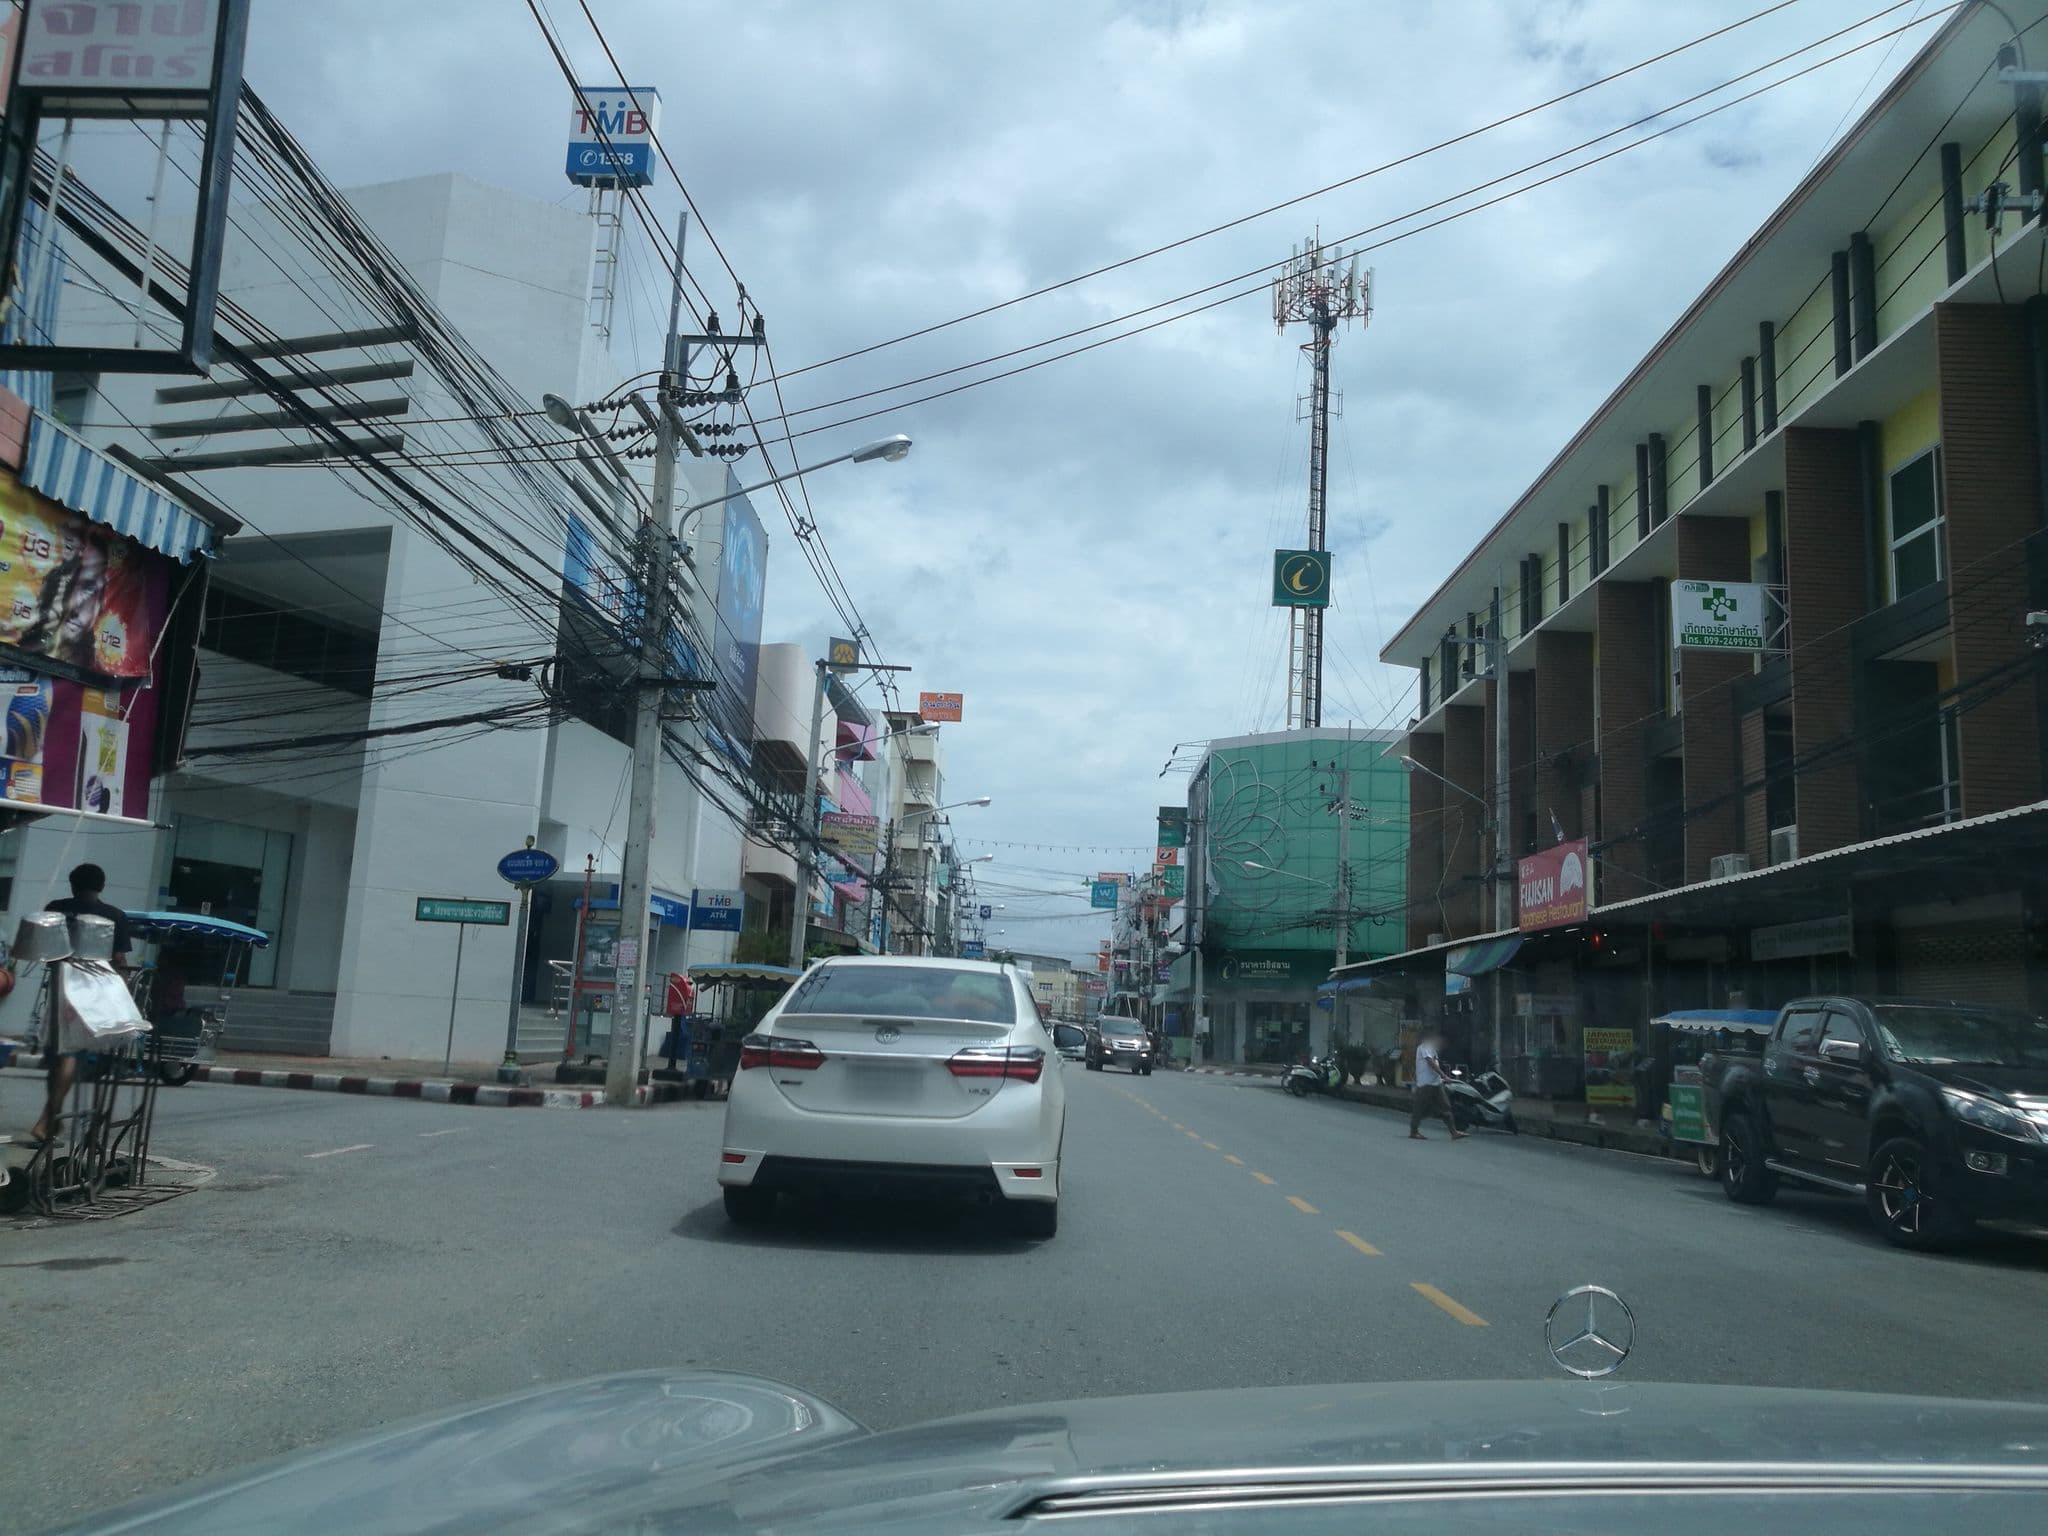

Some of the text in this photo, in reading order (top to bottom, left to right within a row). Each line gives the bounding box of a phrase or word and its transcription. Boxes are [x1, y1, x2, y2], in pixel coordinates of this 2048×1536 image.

[575, 100, 648, 135] TMB
[1684, 622, 1759, 636] เกิดทองรักษาสัตว์
[1685, 634, 1759, 647] โทร. 099-2499163
[1520, 876, 1554, 908] FUJISAN
[708, 894, 732, 907] TMB
[709, 910, 727, 919] ATM
